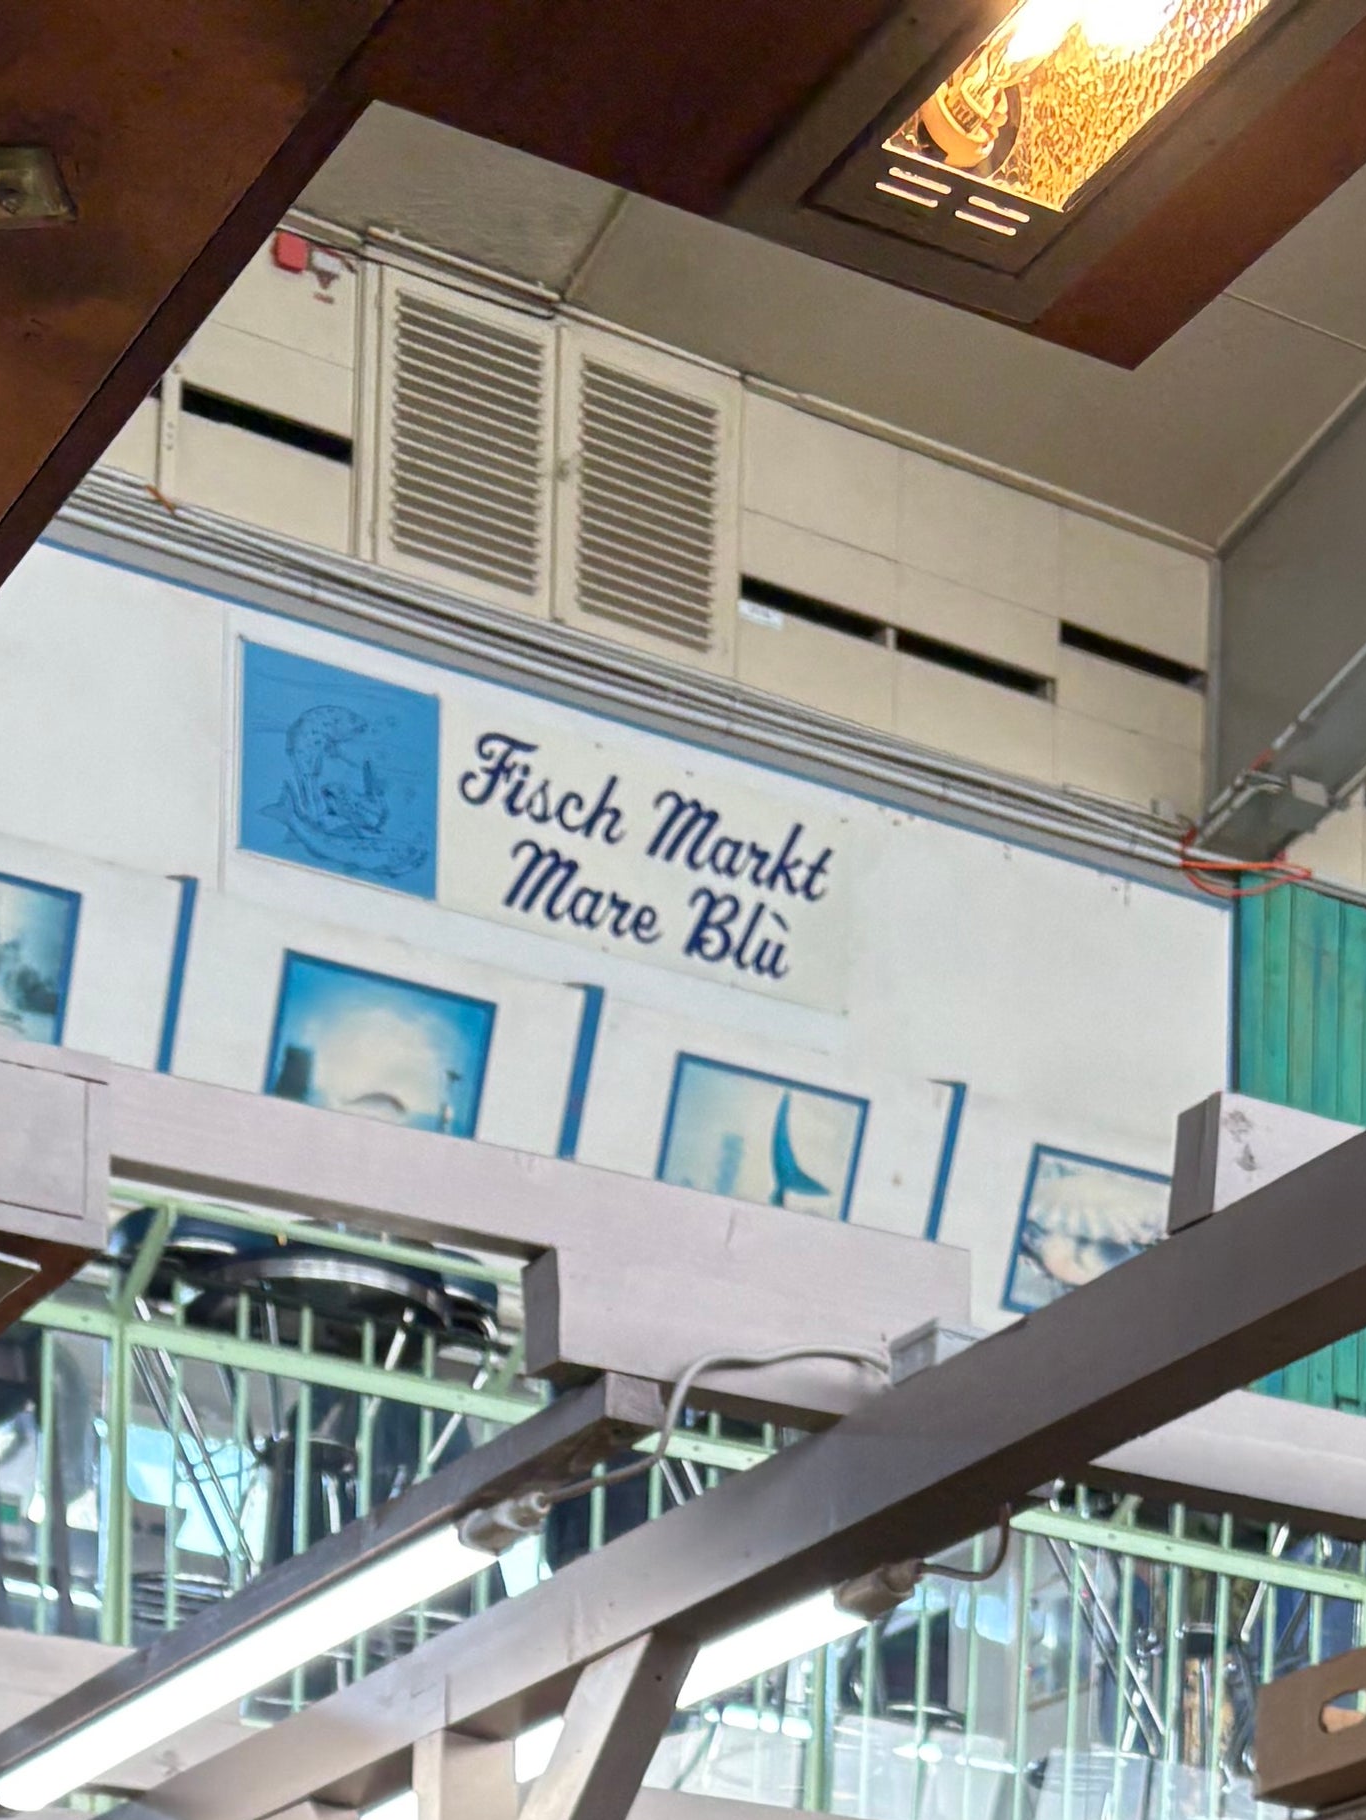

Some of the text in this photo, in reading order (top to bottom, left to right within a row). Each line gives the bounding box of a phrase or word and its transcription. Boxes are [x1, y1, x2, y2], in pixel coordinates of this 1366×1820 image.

[457, 730, 835, 904] Fisch Markt
[502, 838, 791, 982] Mare Blù
